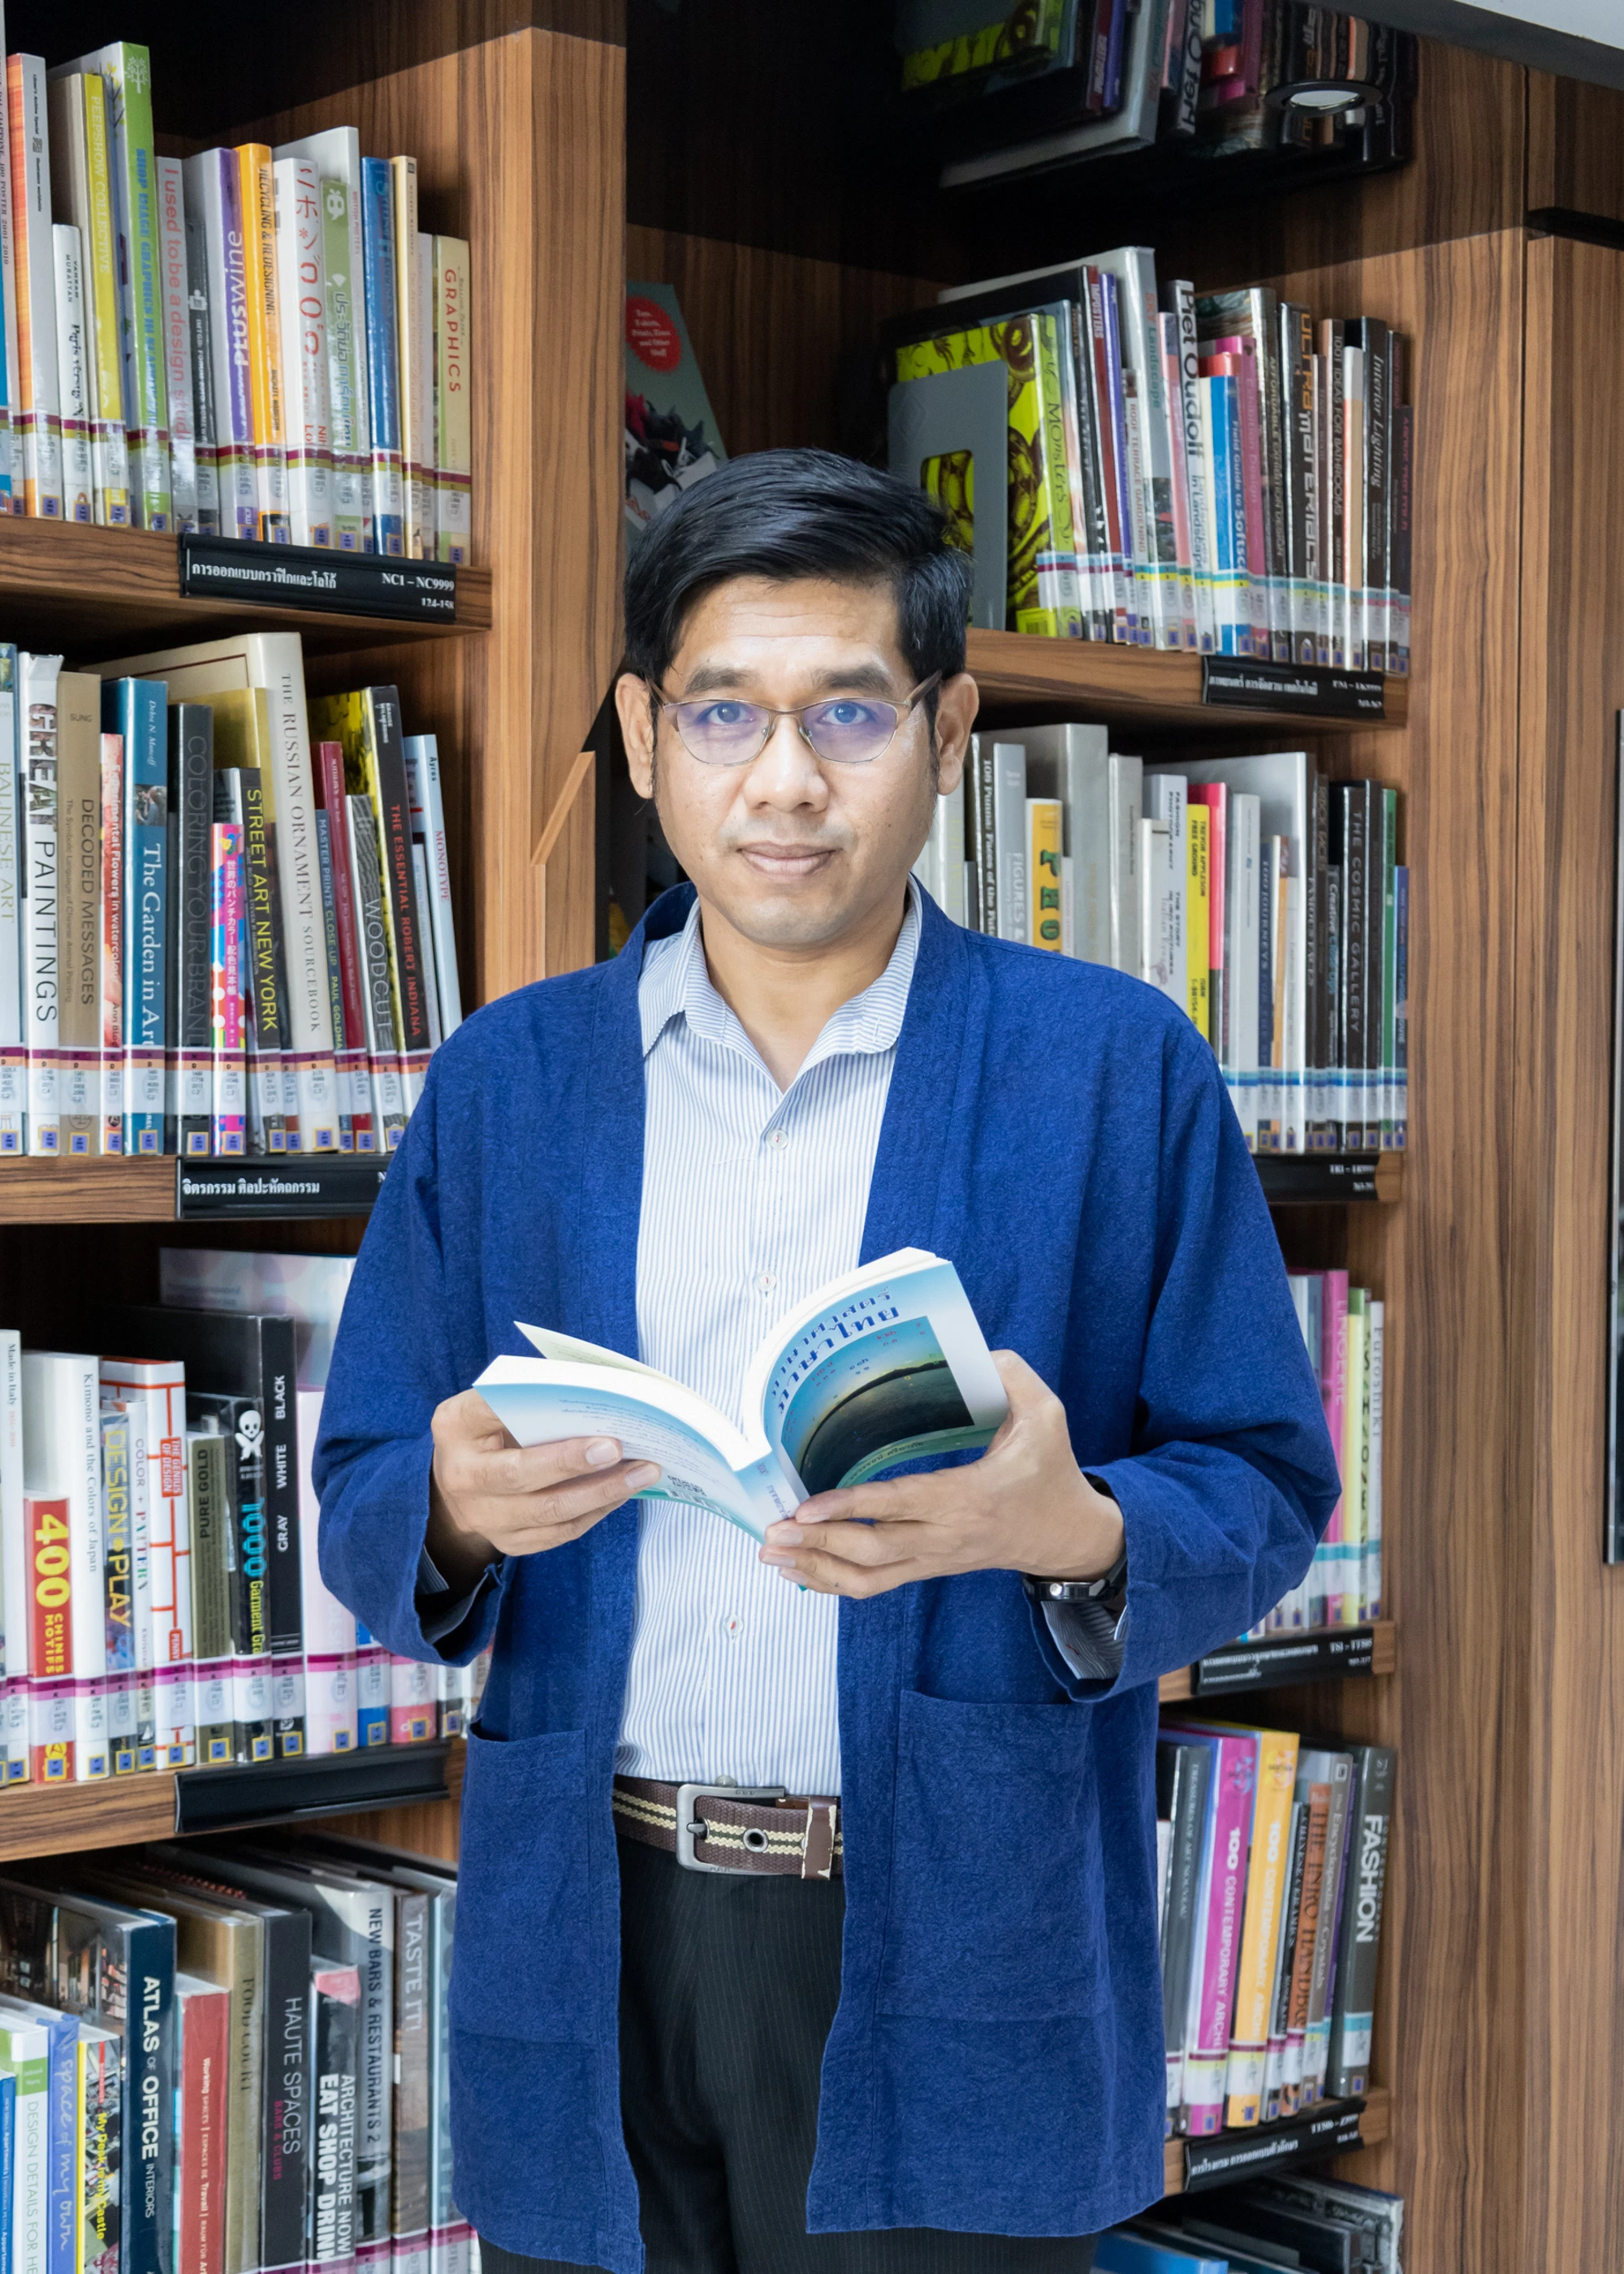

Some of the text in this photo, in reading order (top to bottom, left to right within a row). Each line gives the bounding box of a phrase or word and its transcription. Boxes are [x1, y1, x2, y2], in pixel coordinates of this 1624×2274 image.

[91, 96, 110, 275] PEEPSHOW COLLECTIVE
[165, 179, 182, 232] used
[167, 240, 183, 258] to
[168, 262, 184, 288] be
[259, 169, 275, 315] RECYCLING & REDESIGNING
[168, 311, 187, 381] design
[169, 294, 180, 307] a
[444, 269, 461, 392] GRAPHICS
[1091, 283, 1104, 338] IMPOSTERS
[1181, 289, 1204, 459] Piet Oudolf
[1374, 354, 1384, 416] Interior
[1333, 408, 1344, 515] FOR BATHROOMS
[1370, 419, 1384, 488] Lighting
[1135, 488, 1146, 552] GARDENING
[382, 573, 405, 586] NC1
[70, 714, 93, 722] SUNG
[28, 703, 58, 1022] GREAT PAINTINGS
[64, 856, 74, 894] Language
[110, 764, 121, 983] Experimental Flowers in watercolour
[187, 735, 208, 957] COLORING YOUR
[281, 673, 321, 1032] THE RUSSIAN ORNAMENT SOURCEBOOK
[434, 830, 450, 901] MONOTYPE
[1013, 853, 1025, 923] FIGURES
[1, 879, 15, 923] ART
[66, 906, 74, 938] Chinese
[81, 799, 95, 1005] DECODED MESSAGES
[142, 843, 162, 1045] The Garden in Art
[247, 789, 279, 1031] STREET ART NEW YORK
[318, 819, 340, 1001] MASTER PRINTS CLOSE-UP PAUL
[390, 804, 421, 1036] THE ESSENTIAL ROBERT INDIANA
[1329, 884, 1337, 932] Creative
[1350, 812, 1362, 1033] THE COSMIC GALLERY
[64, 971, 74, 1003] Painting
[66, 941, 74, 969] Animal
[364, 898, 392, 1029] WOODCUT
[112, 1002, 120, 1022] Ann
[182, 1177, 320, 1195] จิตรกรรม ศิลปะหัตถกรรม
[7, 1343, 16, 1370] Made
[7, 1384, 17, 1405] Italy
[8, 1373, 16, 1382] in
[778, 1307, 900, 1415] ภาษาไทย
[1336, 1300, 1348, 1406] LINGERIE
[84, 1373, 98, 1573] Kimono and the Colors of Japan
[163, 1443, 172, 1491] OF DESIGN
[171, 1440, 182, 1493] THE GENIUS
[197, 1450, 210, 1538] PURE GOLD
[274, 1375, 288, 1552] GRAY WHITE BLACK
[135, 1438, 148, 1589] COLOR PATTERN
[35, 1514, 70, 1608] 400
[242, 1497, 266, 1632] 1000 Garment
[45, 1614, 54, 1674] MOTIFS
[171, 1633, 180, 1659] PENNY
[1310, 1812, 1330, 1852] THE
[1217, 1827, 1241, 1995] 100 CONTEMPORARY
[1256, 1820, 1281, 1988] 100 CONTEMPORARY
[1356, 1814, 1384, 1943] FASHION
[405, 1913, 423, 1994] TASTE
[240, 1975, 255, 2091] FOOD COURT
[367, 1908, 382, 2144] NEW BARS & RESTAURANTS 2
[95, 2112, 108, 2131] My
[141, 1976, 160, 2218] ATLAS OF OFFICE INTERIORS
[283, 1997, 303, 2155] HAUTE SPACES
[52, 2059, 75, 2252] space my own
[97, 2134, 107, 2163] Desk
[201, 2057, 210, 2211] Working Travail
[273, 2099, 283, 2180] BARS CLUBS
[317, 2073, 339, 2185] EAT SHOP
[338, 2074, 355, 2207] ARCHITECTURE
[27, 2101, 39, 2251] DESIGN DETAILS FOR
[96, 2202, 107, 2240] Castle
